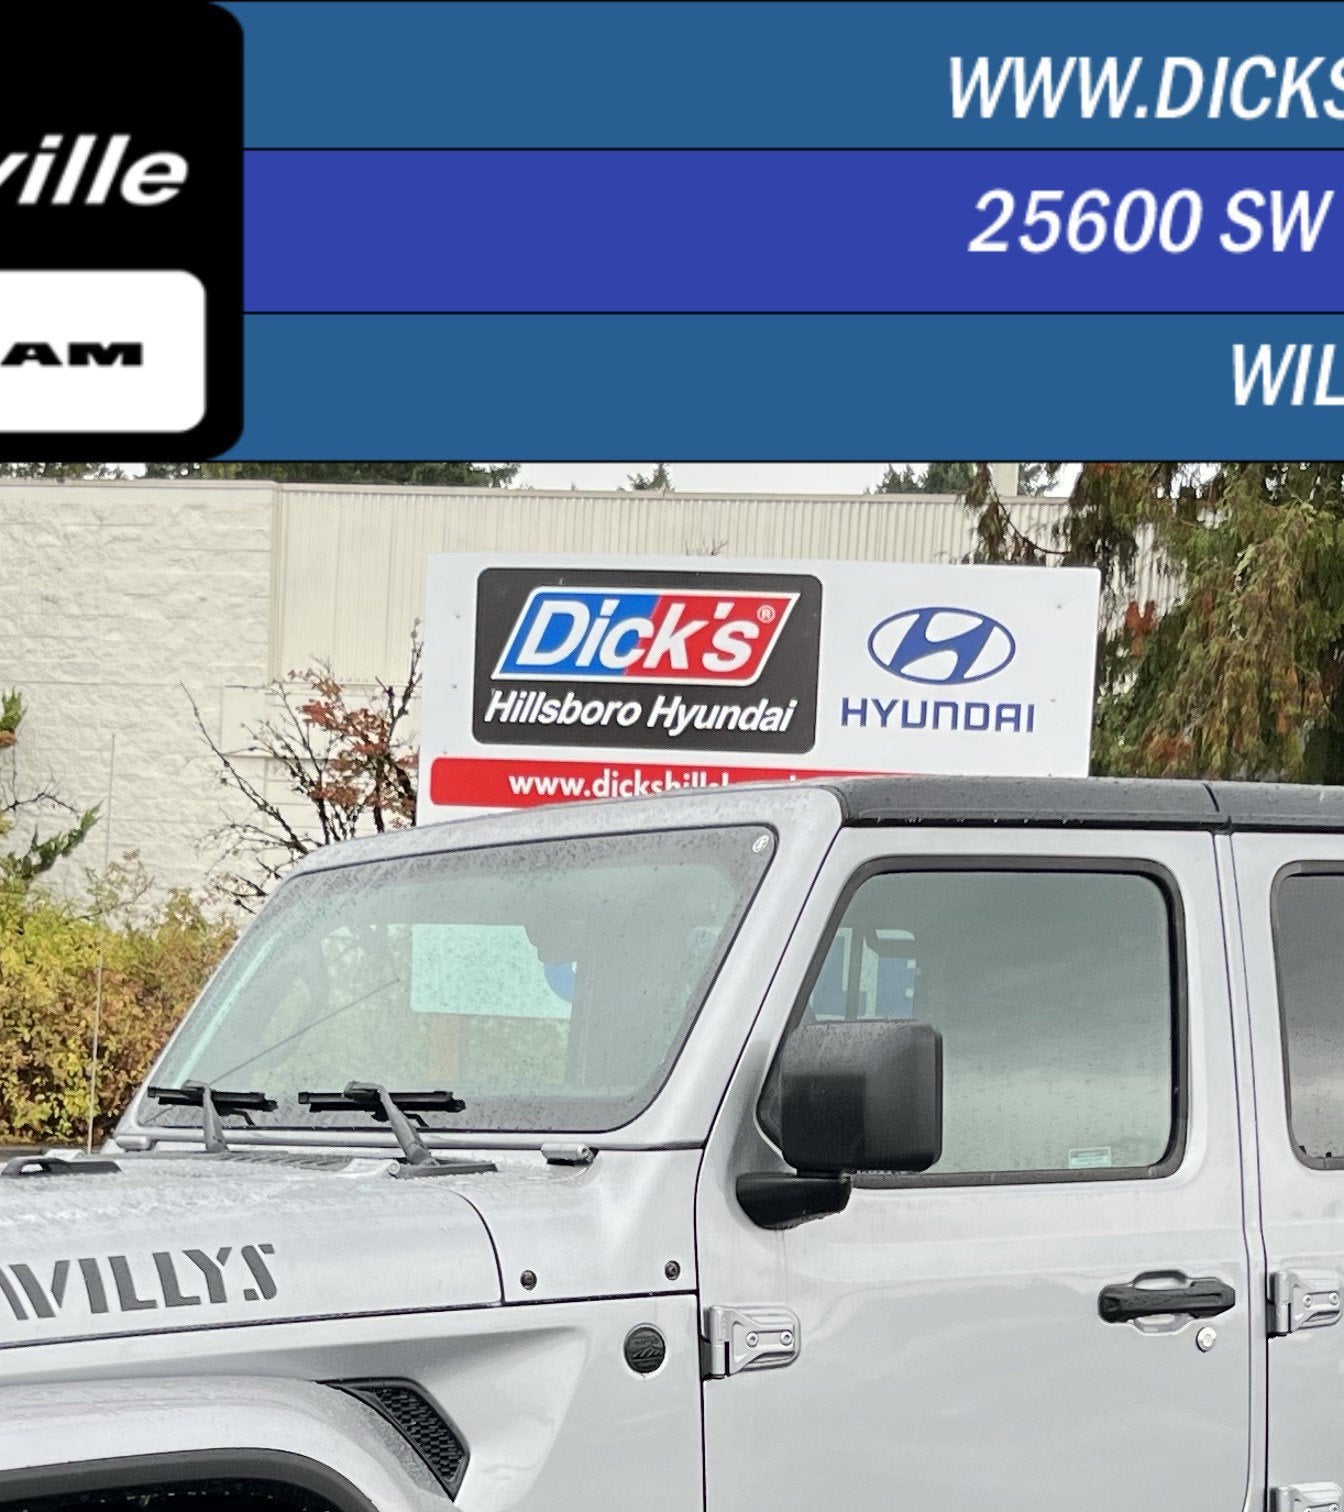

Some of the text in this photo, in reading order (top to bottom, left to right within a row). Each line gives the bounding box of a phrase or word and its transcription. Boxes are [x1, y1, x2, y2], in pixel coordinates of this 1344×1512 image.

[516, 599, 760, 673] Dick's
[484, 690, 798, 737] Hillsboro Hyundai
[840, 696, 1035, 733] HYUNDAI
